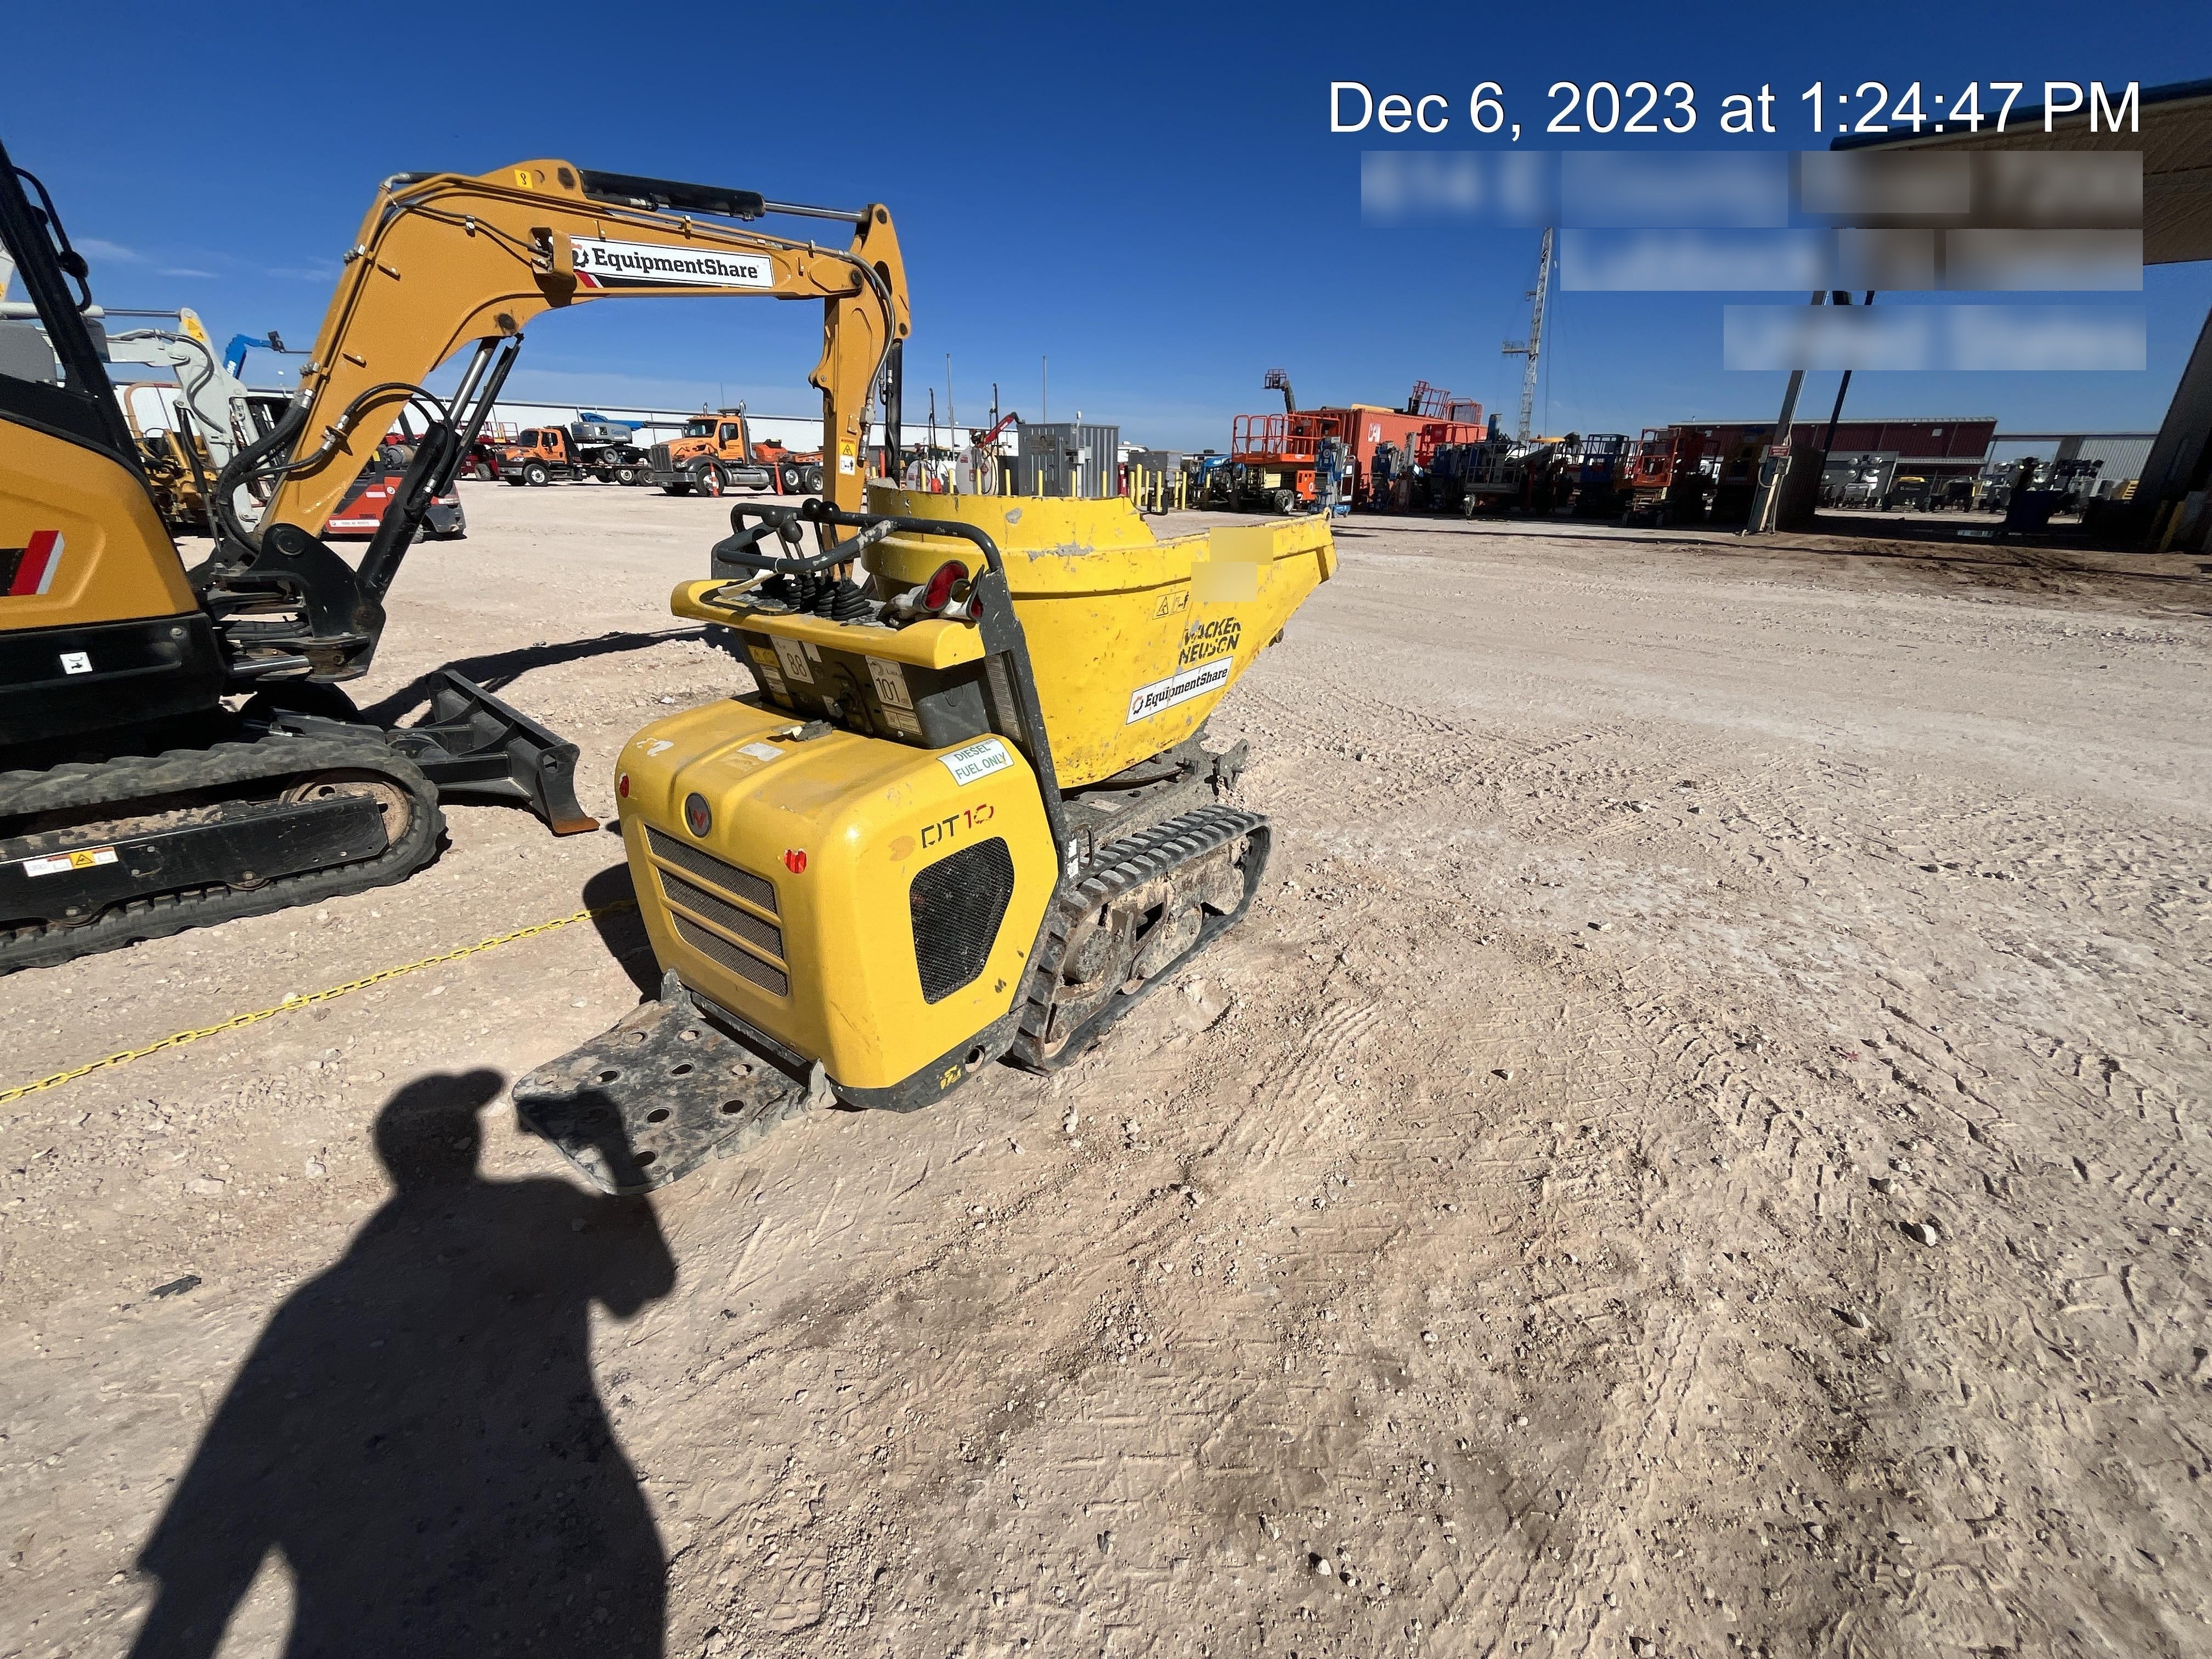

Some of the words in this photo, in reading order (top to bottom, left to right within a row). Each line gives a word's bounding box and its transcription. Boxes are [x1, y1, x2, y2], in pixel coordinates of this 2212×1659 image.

[591, 247, 758, 279] EquipmentShare
[786, 652, 808, 678] 88
[876, 677, 900, 703] 101
[1144, 668, 1228, 707] EquipmentShare
[953, 744, 991, 761] DIESEL
[955, 762, 983, 780] FUEL
[982, 752, 1007, 769] ONLY
